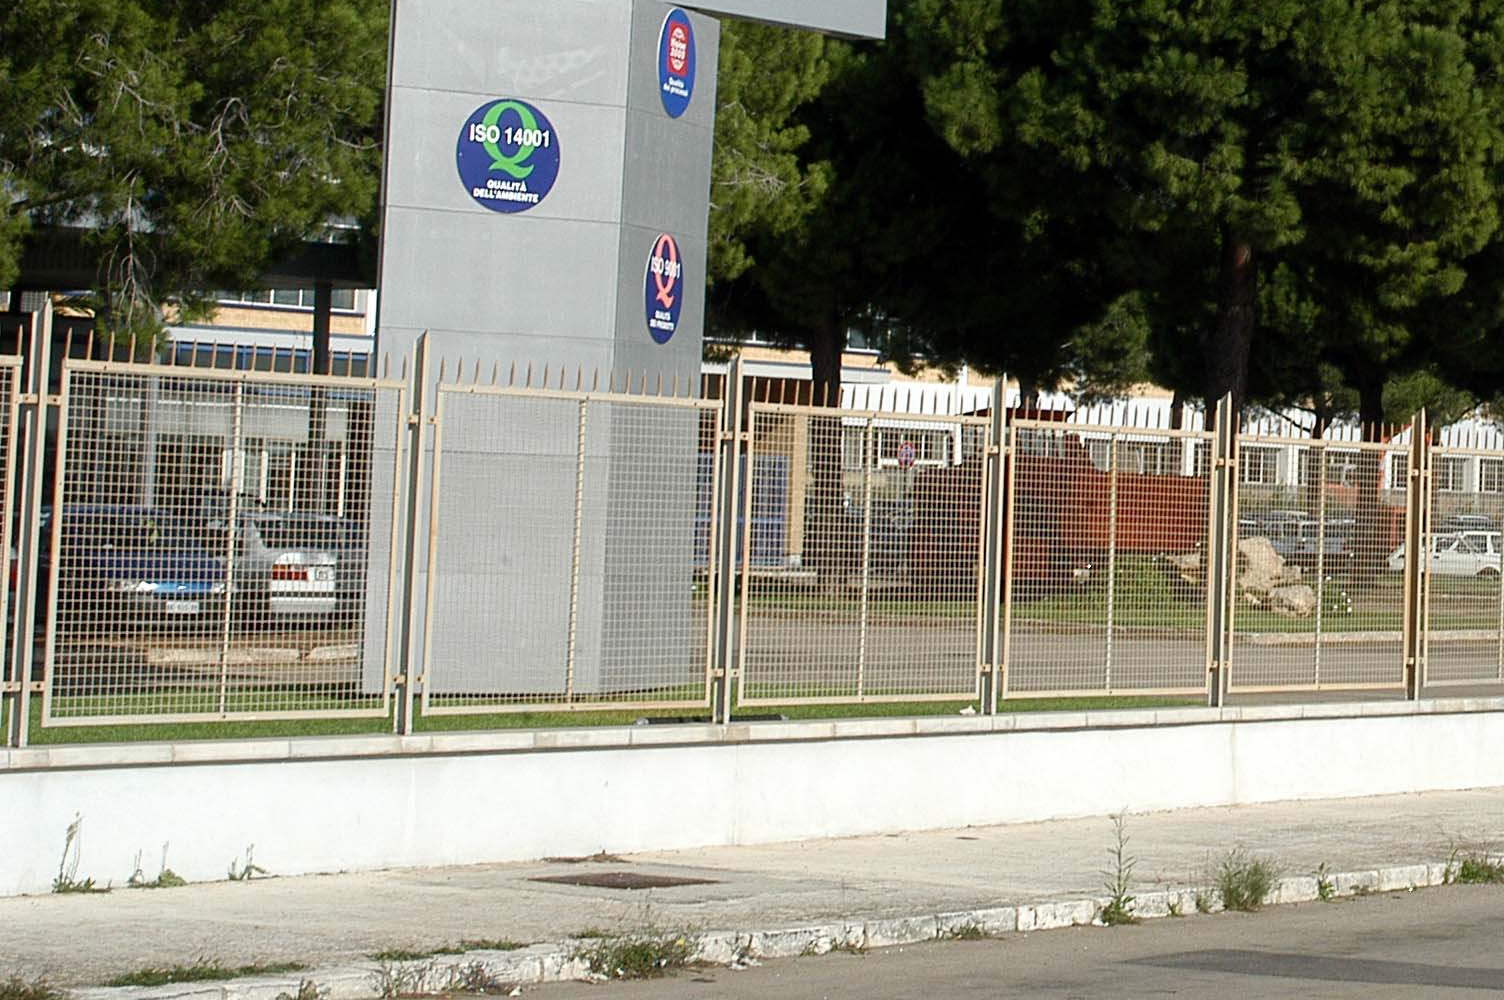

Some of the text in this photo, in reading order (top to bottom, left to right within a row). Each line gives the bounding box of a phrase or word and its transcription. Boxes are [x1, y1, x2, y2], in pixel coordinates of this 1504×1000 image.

[470, 123, 550, 149] ISO 14001
[650, 255, 665, 275] ISO
